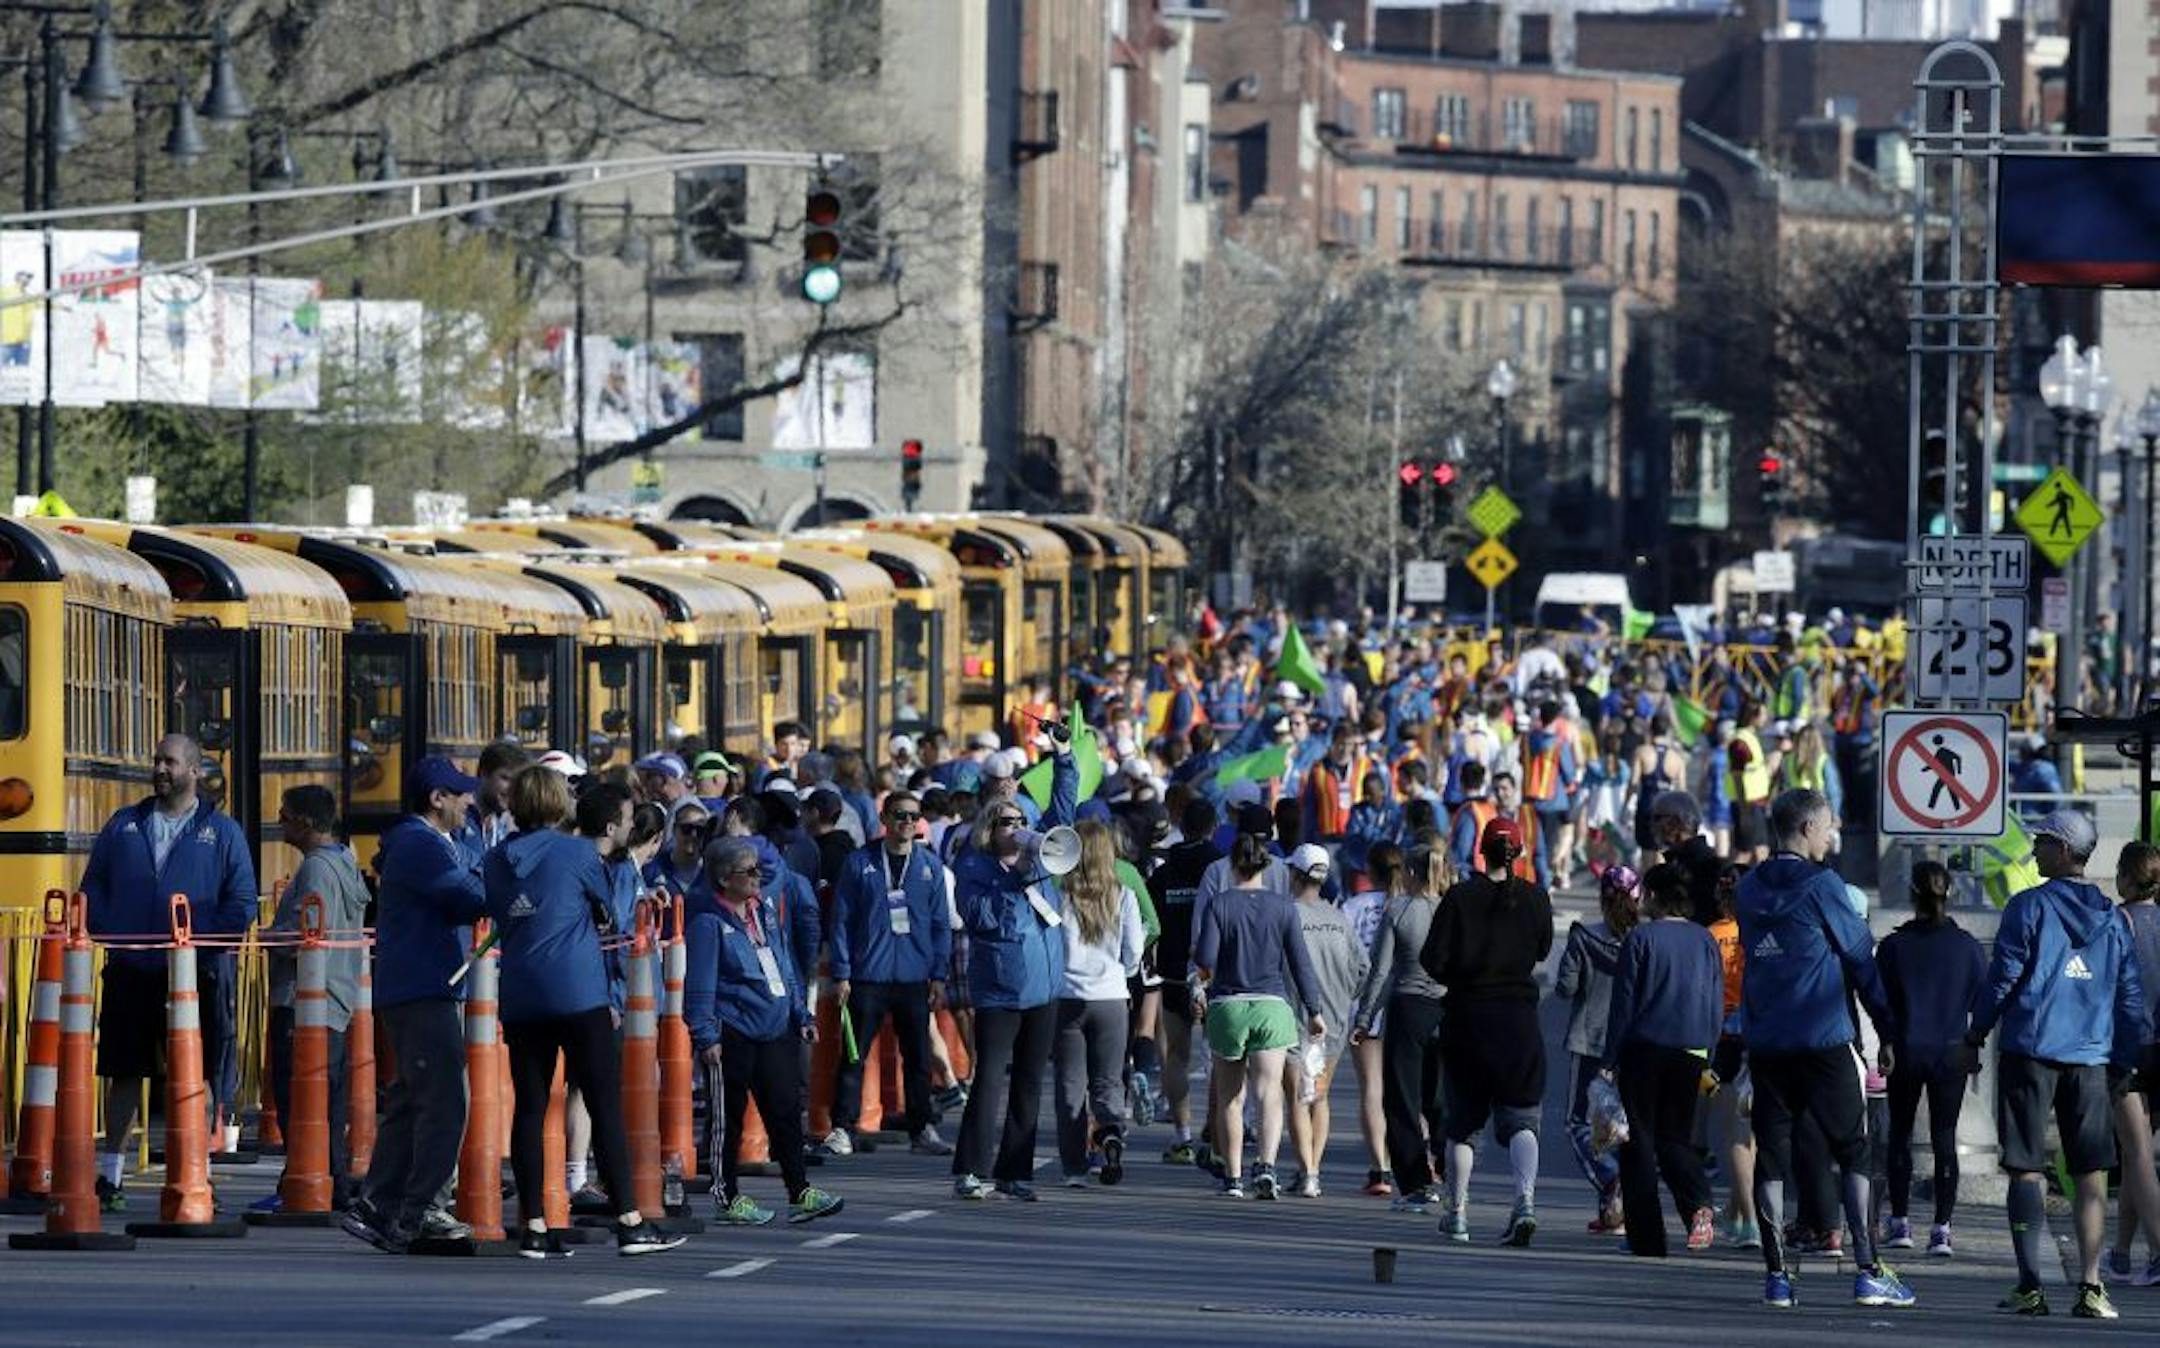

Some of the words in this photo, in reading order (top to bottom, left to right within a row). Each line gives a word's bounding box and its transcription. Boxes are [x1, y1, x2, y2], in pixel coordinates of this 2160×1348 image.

[1925, 547, 2021, 579] NORTH
[1928, 619, 2014, 676] 28
[1302, 923, 1345, 935] ANTAS
